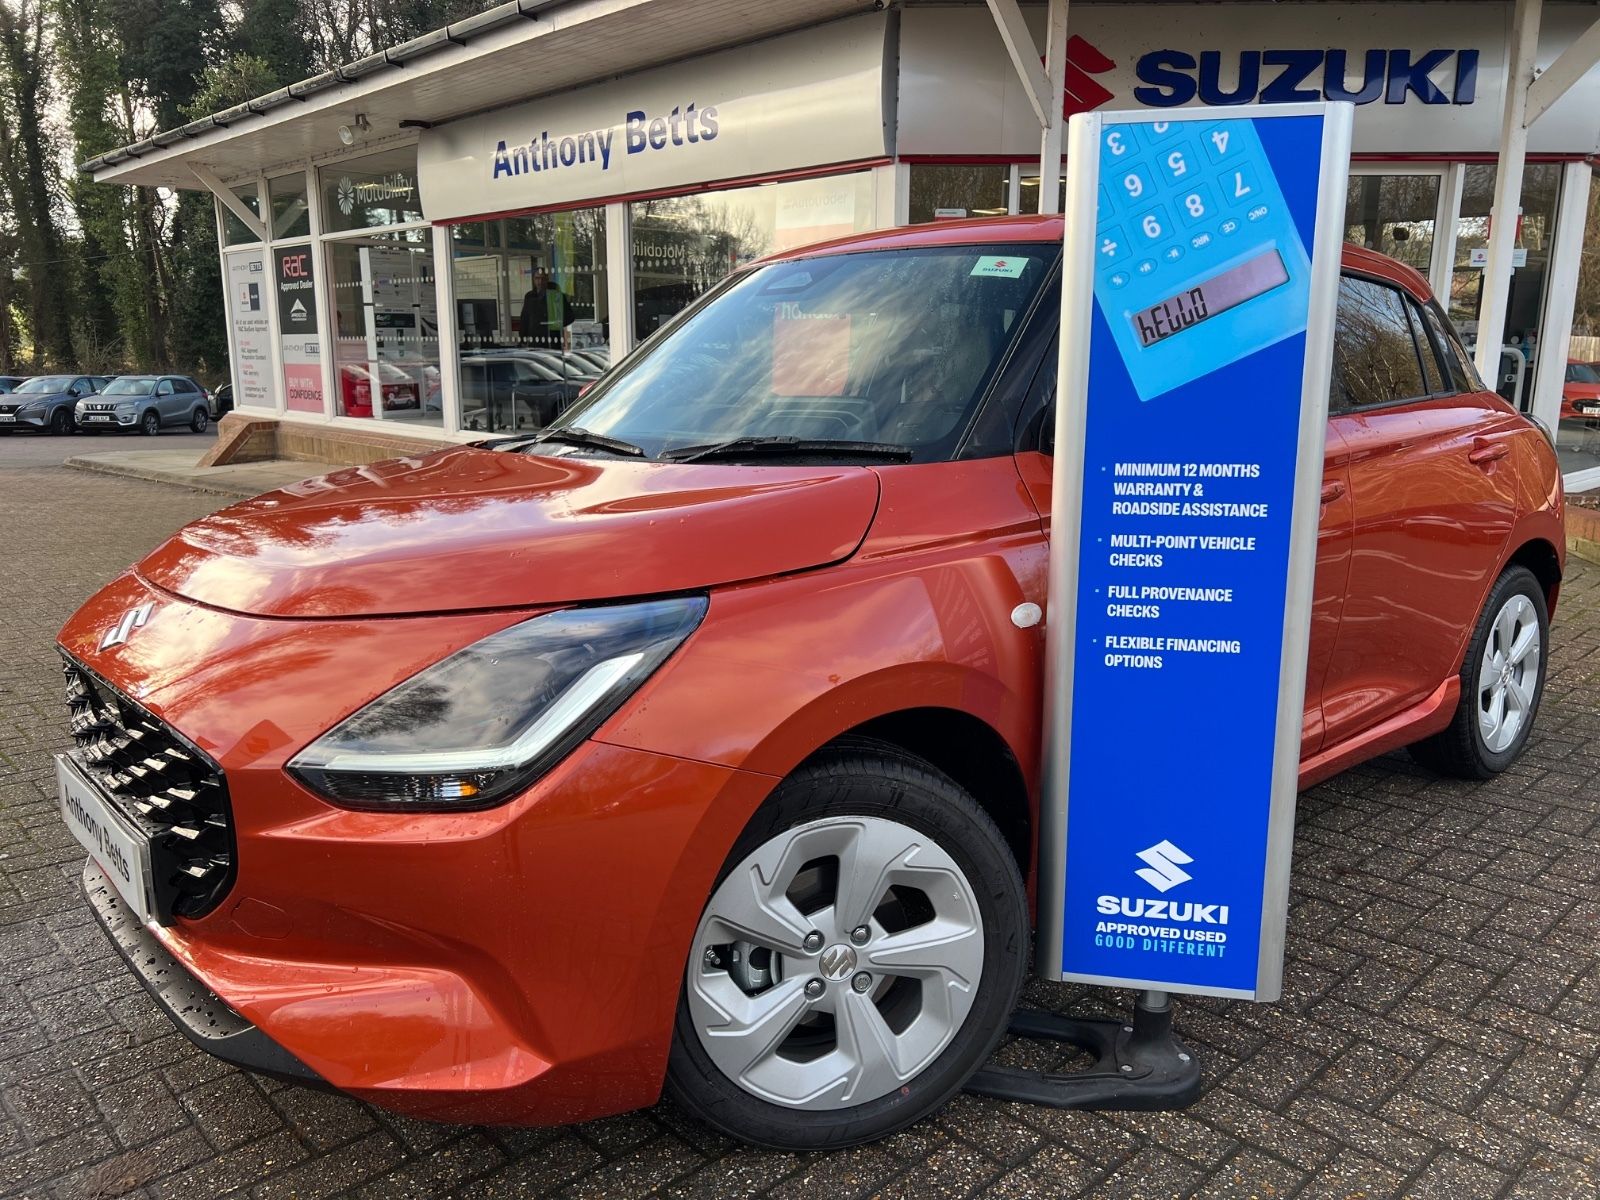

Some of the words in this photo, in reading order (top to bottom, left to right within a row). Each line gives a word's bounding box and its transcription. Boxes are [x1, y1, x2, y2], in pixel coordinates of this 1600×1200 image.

[1133, 48, 1480, 106] SUZUKI
[493, 128, 614, 179] Anthony
[626, 102, 719, 154] Betts
[1211, 130, 1229, 154] 4
[1167, 151, 1187, 177] 5
[356, 173, 413, 204] Motability
[1234, 172, 1251, 198] 7
[1185, 193, 1205, 218] 8
[1222, 221, 1236, 234] CE
[1191, 233, 1210, 248] MRC
[280, 281, 299, 291] Approved
[299, 280, 314, 290] Dealer
[289, 389, 322, 401] CONFIDENCE
[1114, 463, 1181, 477] MINIMUM
[1182, 463, 1197, 477] 12
[1199, 463, 1261, 478] MONTHS
[1113, 482, 1191, 496] WARRANTY
[1193, 483, 1203, 496] &
[1112, 502, 1180, 516] ROADSIDE
[1181, 502, 1268, 517] ASSISTANCE
[1110, 534, 1197, 549] MULTI-POINT
[1199, 536, 1256, 550] VEHICLE
[1109, 553, 1163, 567] CHECKS
[1107, 585, 1139, 599] FULL
[1141, 586, 1233, 602] PROVENANCE
[1106, 604, 1160, 618] CHECKS
[1105, 635, 1164, 650] FLEXIBLE
[1166, 638, 1241, 653] FINANCING
[1104, 654, 1163, 669] OPTIONS
[64, 784, 103, 853] Anthony
[103, 826, 131, 883] Betts
[1096, 895, 1229, 925] SUZUKI
[1095, 921, 1181, 939] APPROVED
[1183, 929, 1227, 943] USED
[1095, 933, 1135, 949] GOOD
[1143, 938, 1227, 958] DIFFERENT
